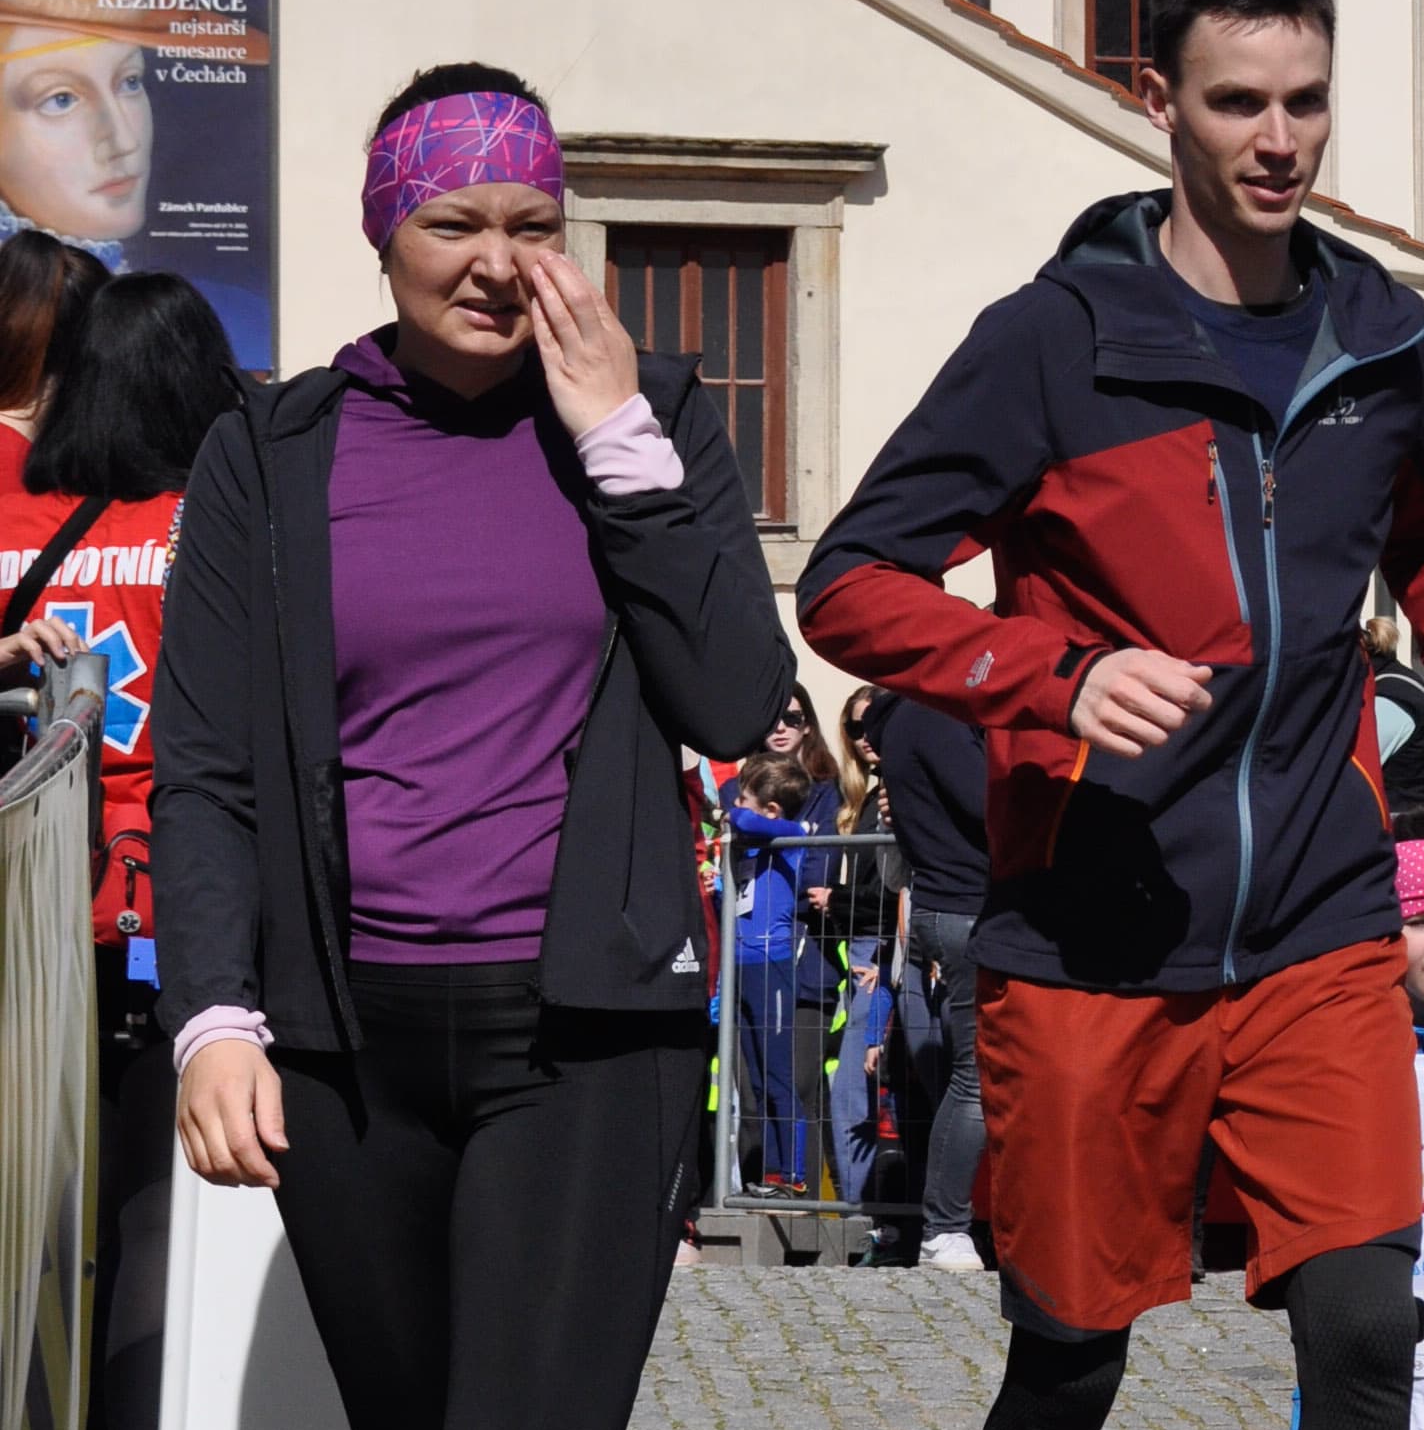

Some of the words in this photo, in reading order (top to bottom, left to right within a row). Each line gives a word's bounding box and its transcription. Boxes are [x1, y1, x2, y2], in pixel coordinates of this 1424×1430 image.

[170, 18, 246, 38] nejstarší
[157, 45, 247, 60] renesance
[155, 69, 168, 82] v
[171, 63, 247, 84] Čechách
